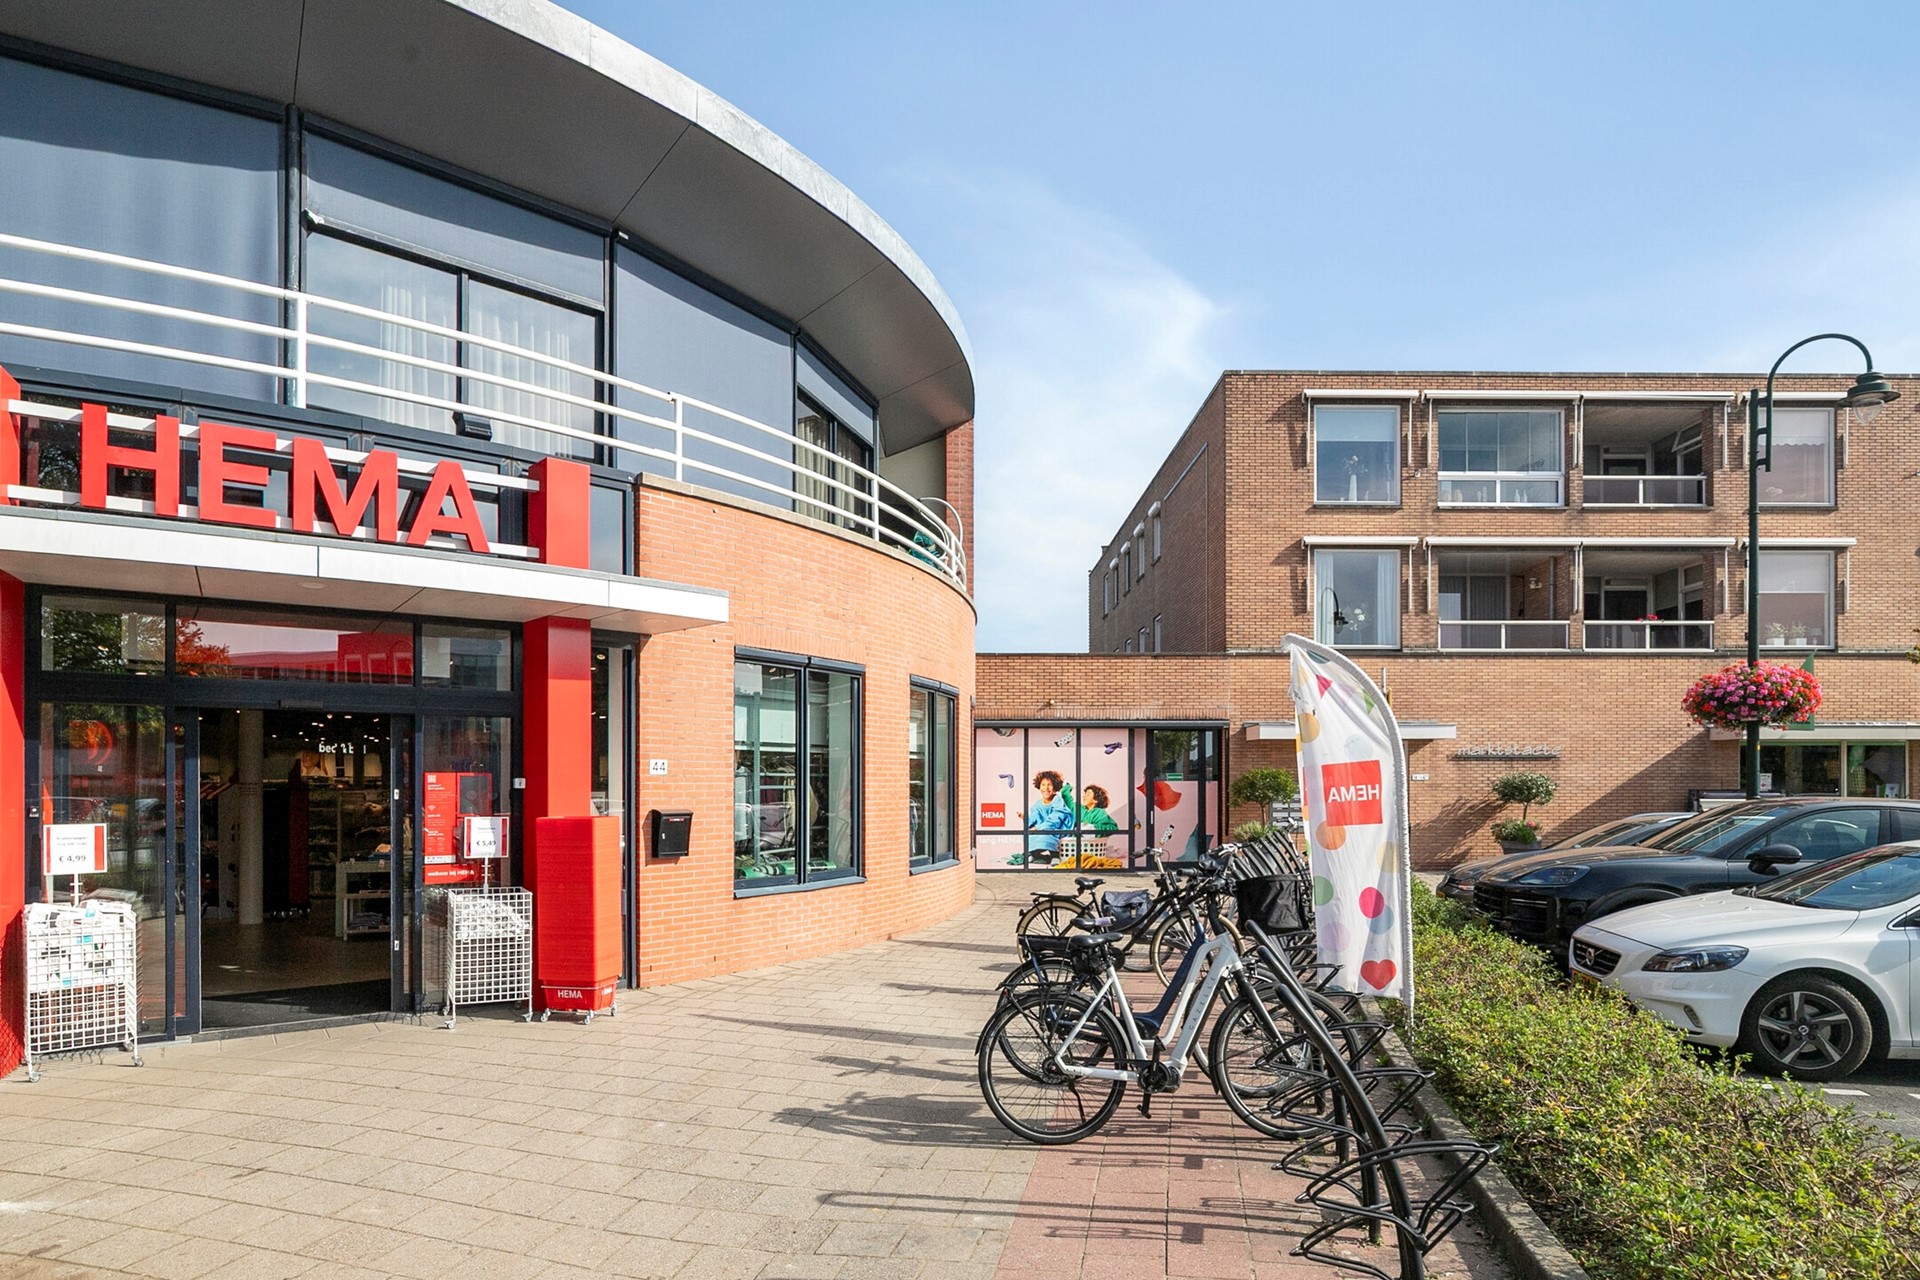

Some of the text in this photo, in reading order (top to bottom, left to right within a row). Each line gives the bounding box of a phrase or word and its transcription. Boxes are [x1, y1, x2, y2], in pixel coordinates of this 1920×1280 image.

[81, 402, 490, 553] HEMA
[652, 761, 666, 772] 44
[66, 855, 86, 863] 4,99
[557, 990, 583, 998] HEMA
[1188, 976, 1216, 1030] GAZELLE
